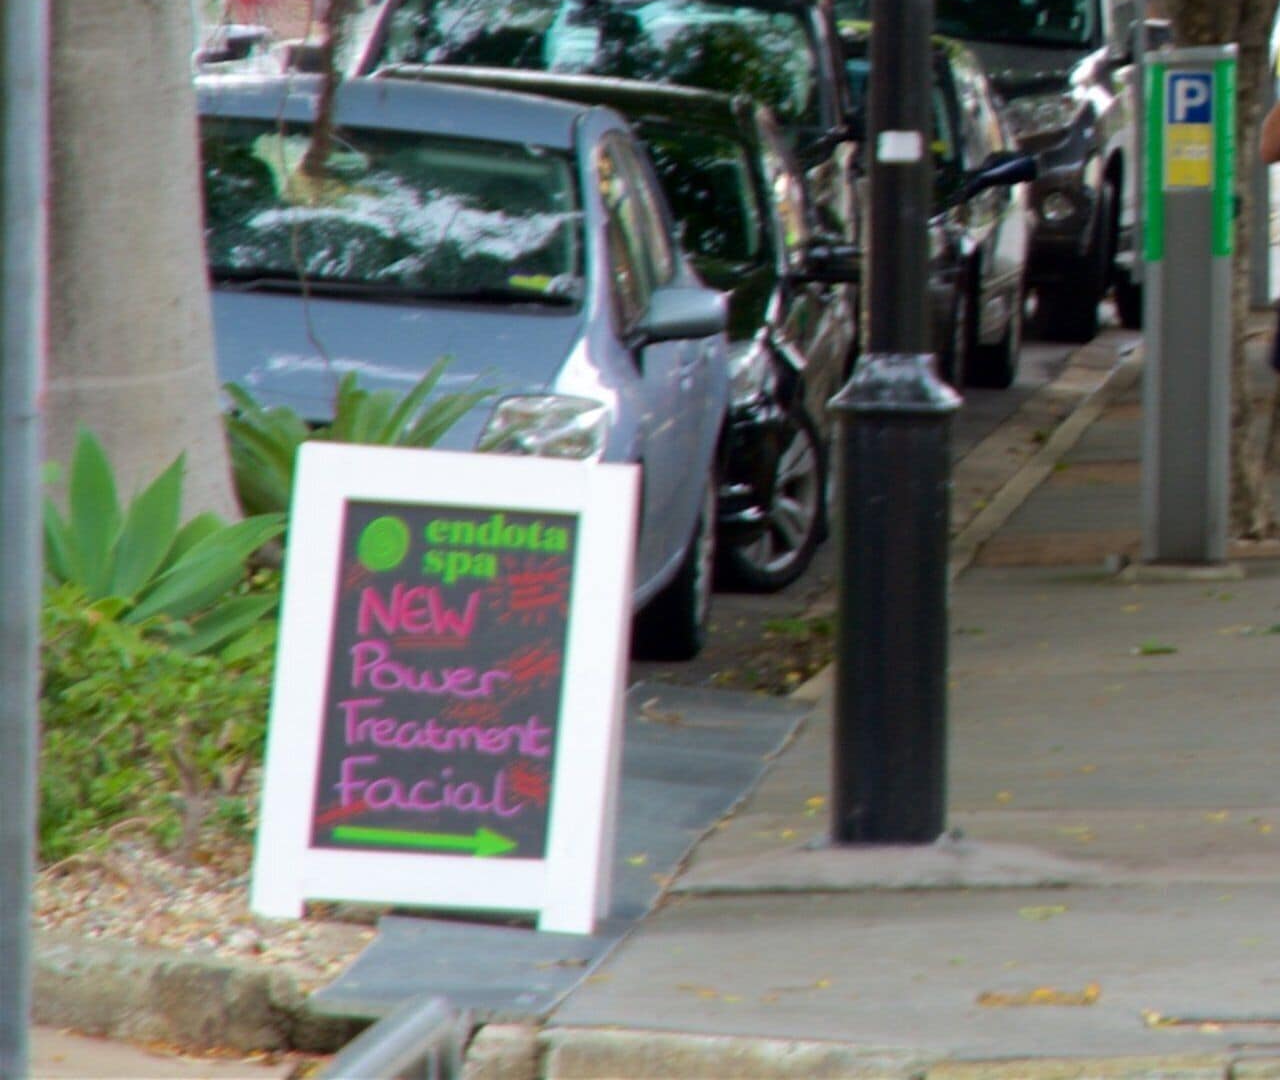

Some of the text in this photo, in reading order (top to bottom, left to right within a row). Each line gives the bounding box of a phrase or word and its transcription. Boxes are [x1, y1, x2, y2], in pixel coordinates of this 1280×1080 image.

[1174, 77, 1208, 121] P
[425, 514, 567, 551] endota
[423, 550, 497, 584] spa
[357, 582, 479, 637] NEW
[350, 640, 508, 698] Power
[338, 698, 550, 758] Treatment
[334, 754, 523, 816] Facial
